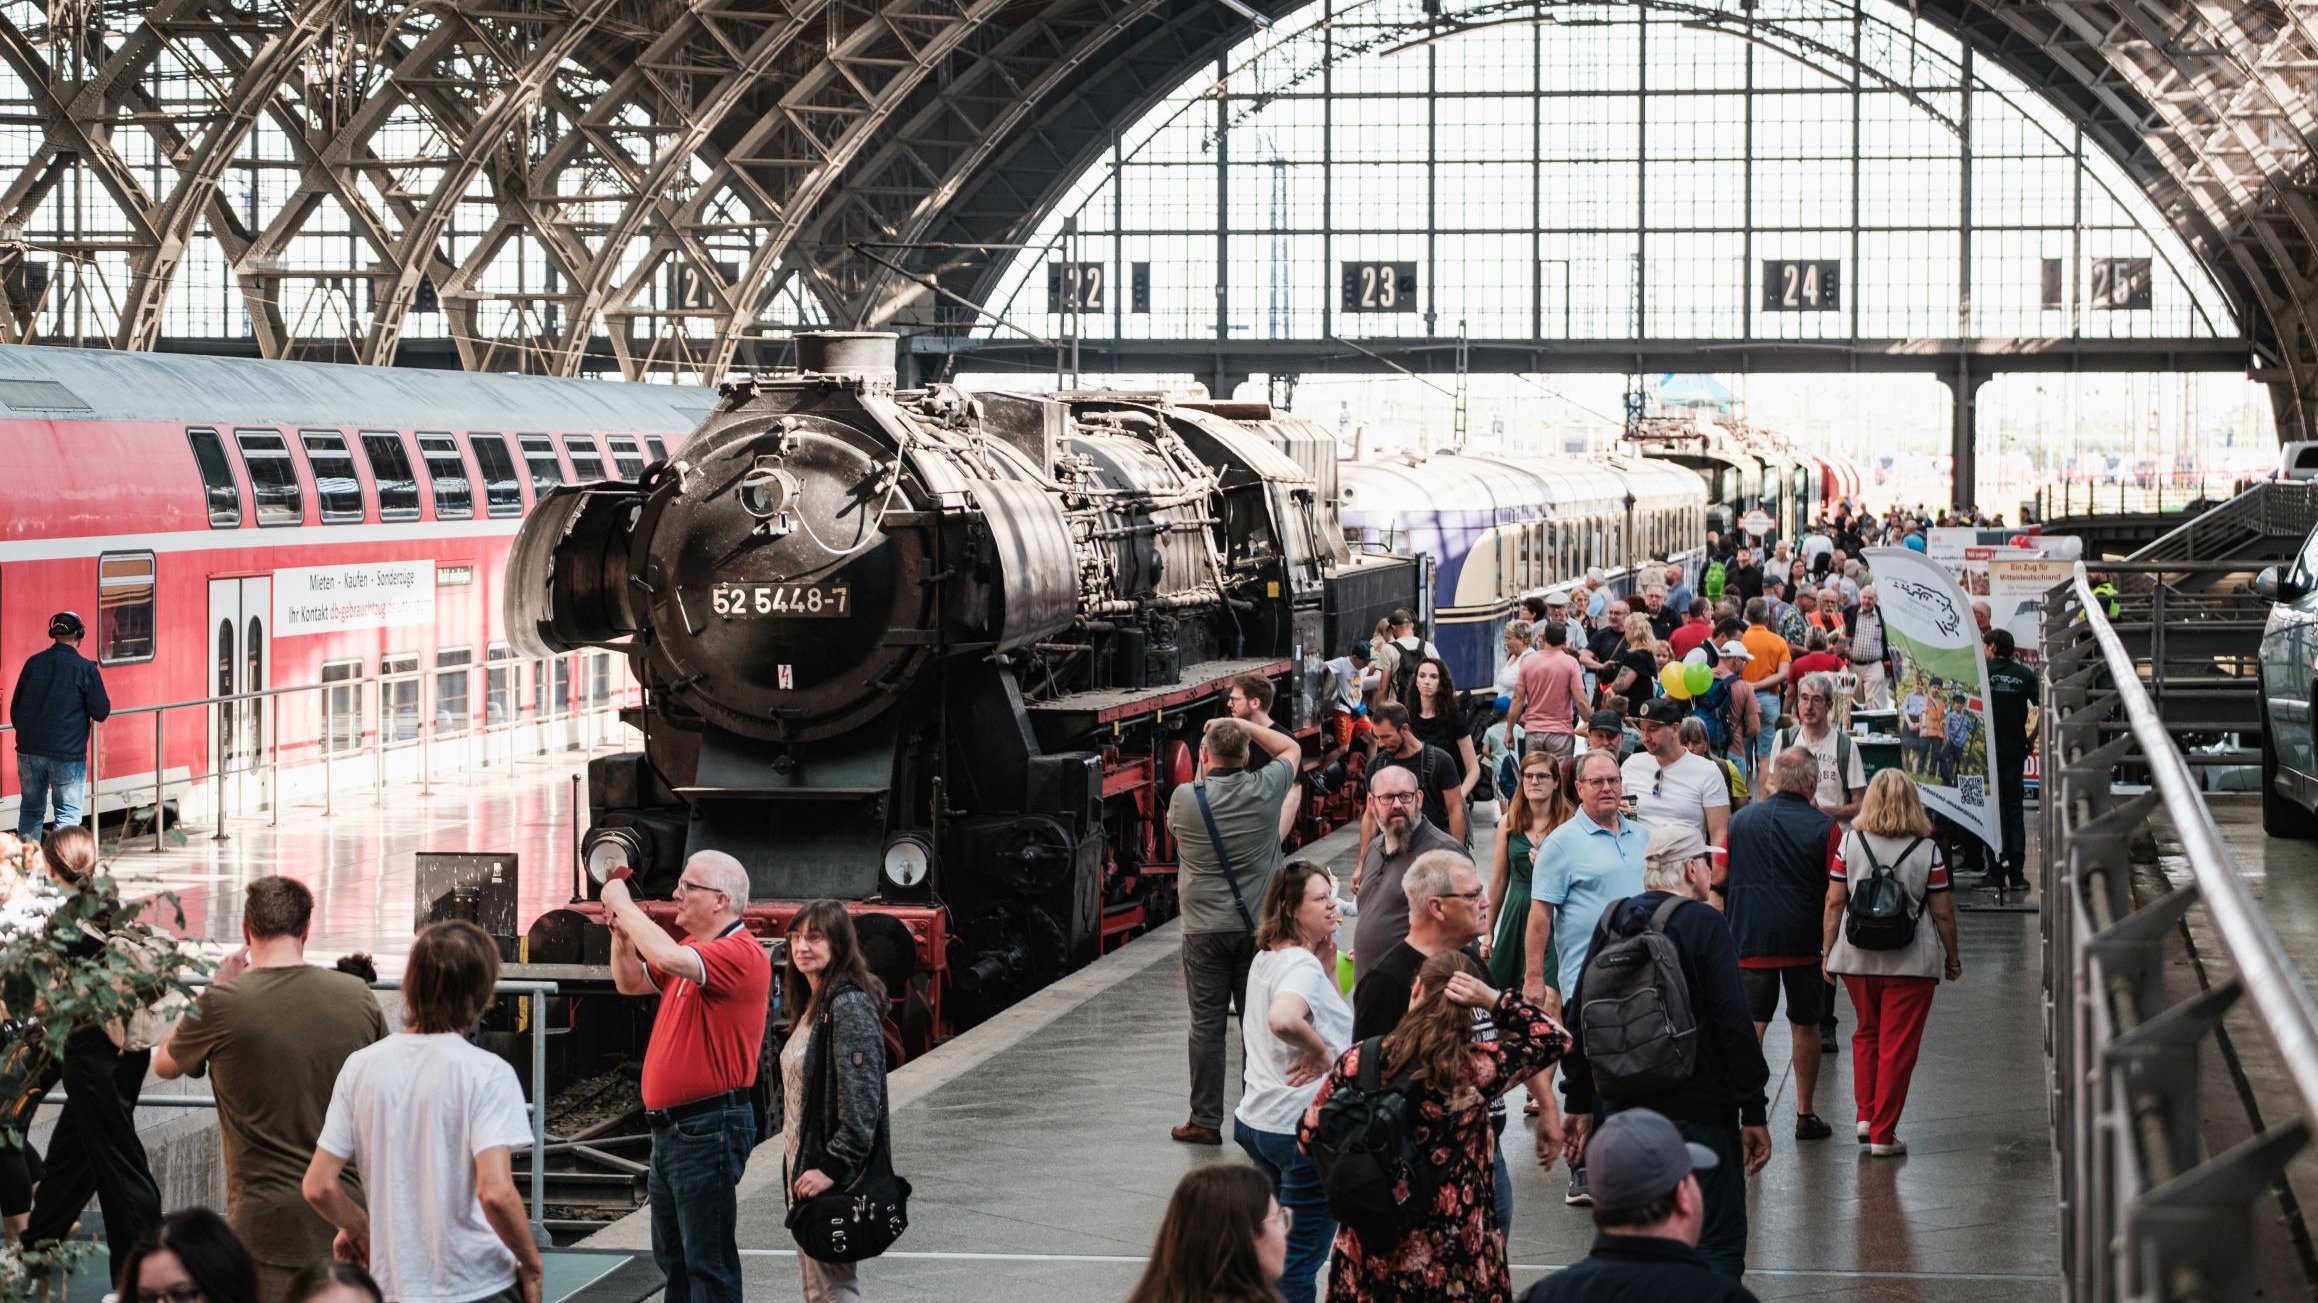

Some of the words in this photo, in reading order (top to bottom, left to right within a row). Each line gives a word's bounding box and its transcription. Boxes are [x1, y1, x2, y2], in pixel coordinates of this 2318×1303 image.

[1361, 265, 1396, 307] 23
[1783, 264, 1819, 306] 24
[2092, 262, 2129, 307] 25
[309, 573, 335, 592] Mieten
[344, 571, 368, 589] Kaufen
[376, 567, 415, 588] Sonderzüge
[1999, 573, 2061, 581] Mitteldeutschland
[2010, 563, 2022, 571] Ein
[2024, 563, 2037, 572] Zug
[2038, 563, 2049, 571] für
[288, 605, 299, 624] Ihr
[301, 603, 329, 623] Kontakt
[712, 588, 747, 614] 52
[754, 587, 847, 614] 5448-7
